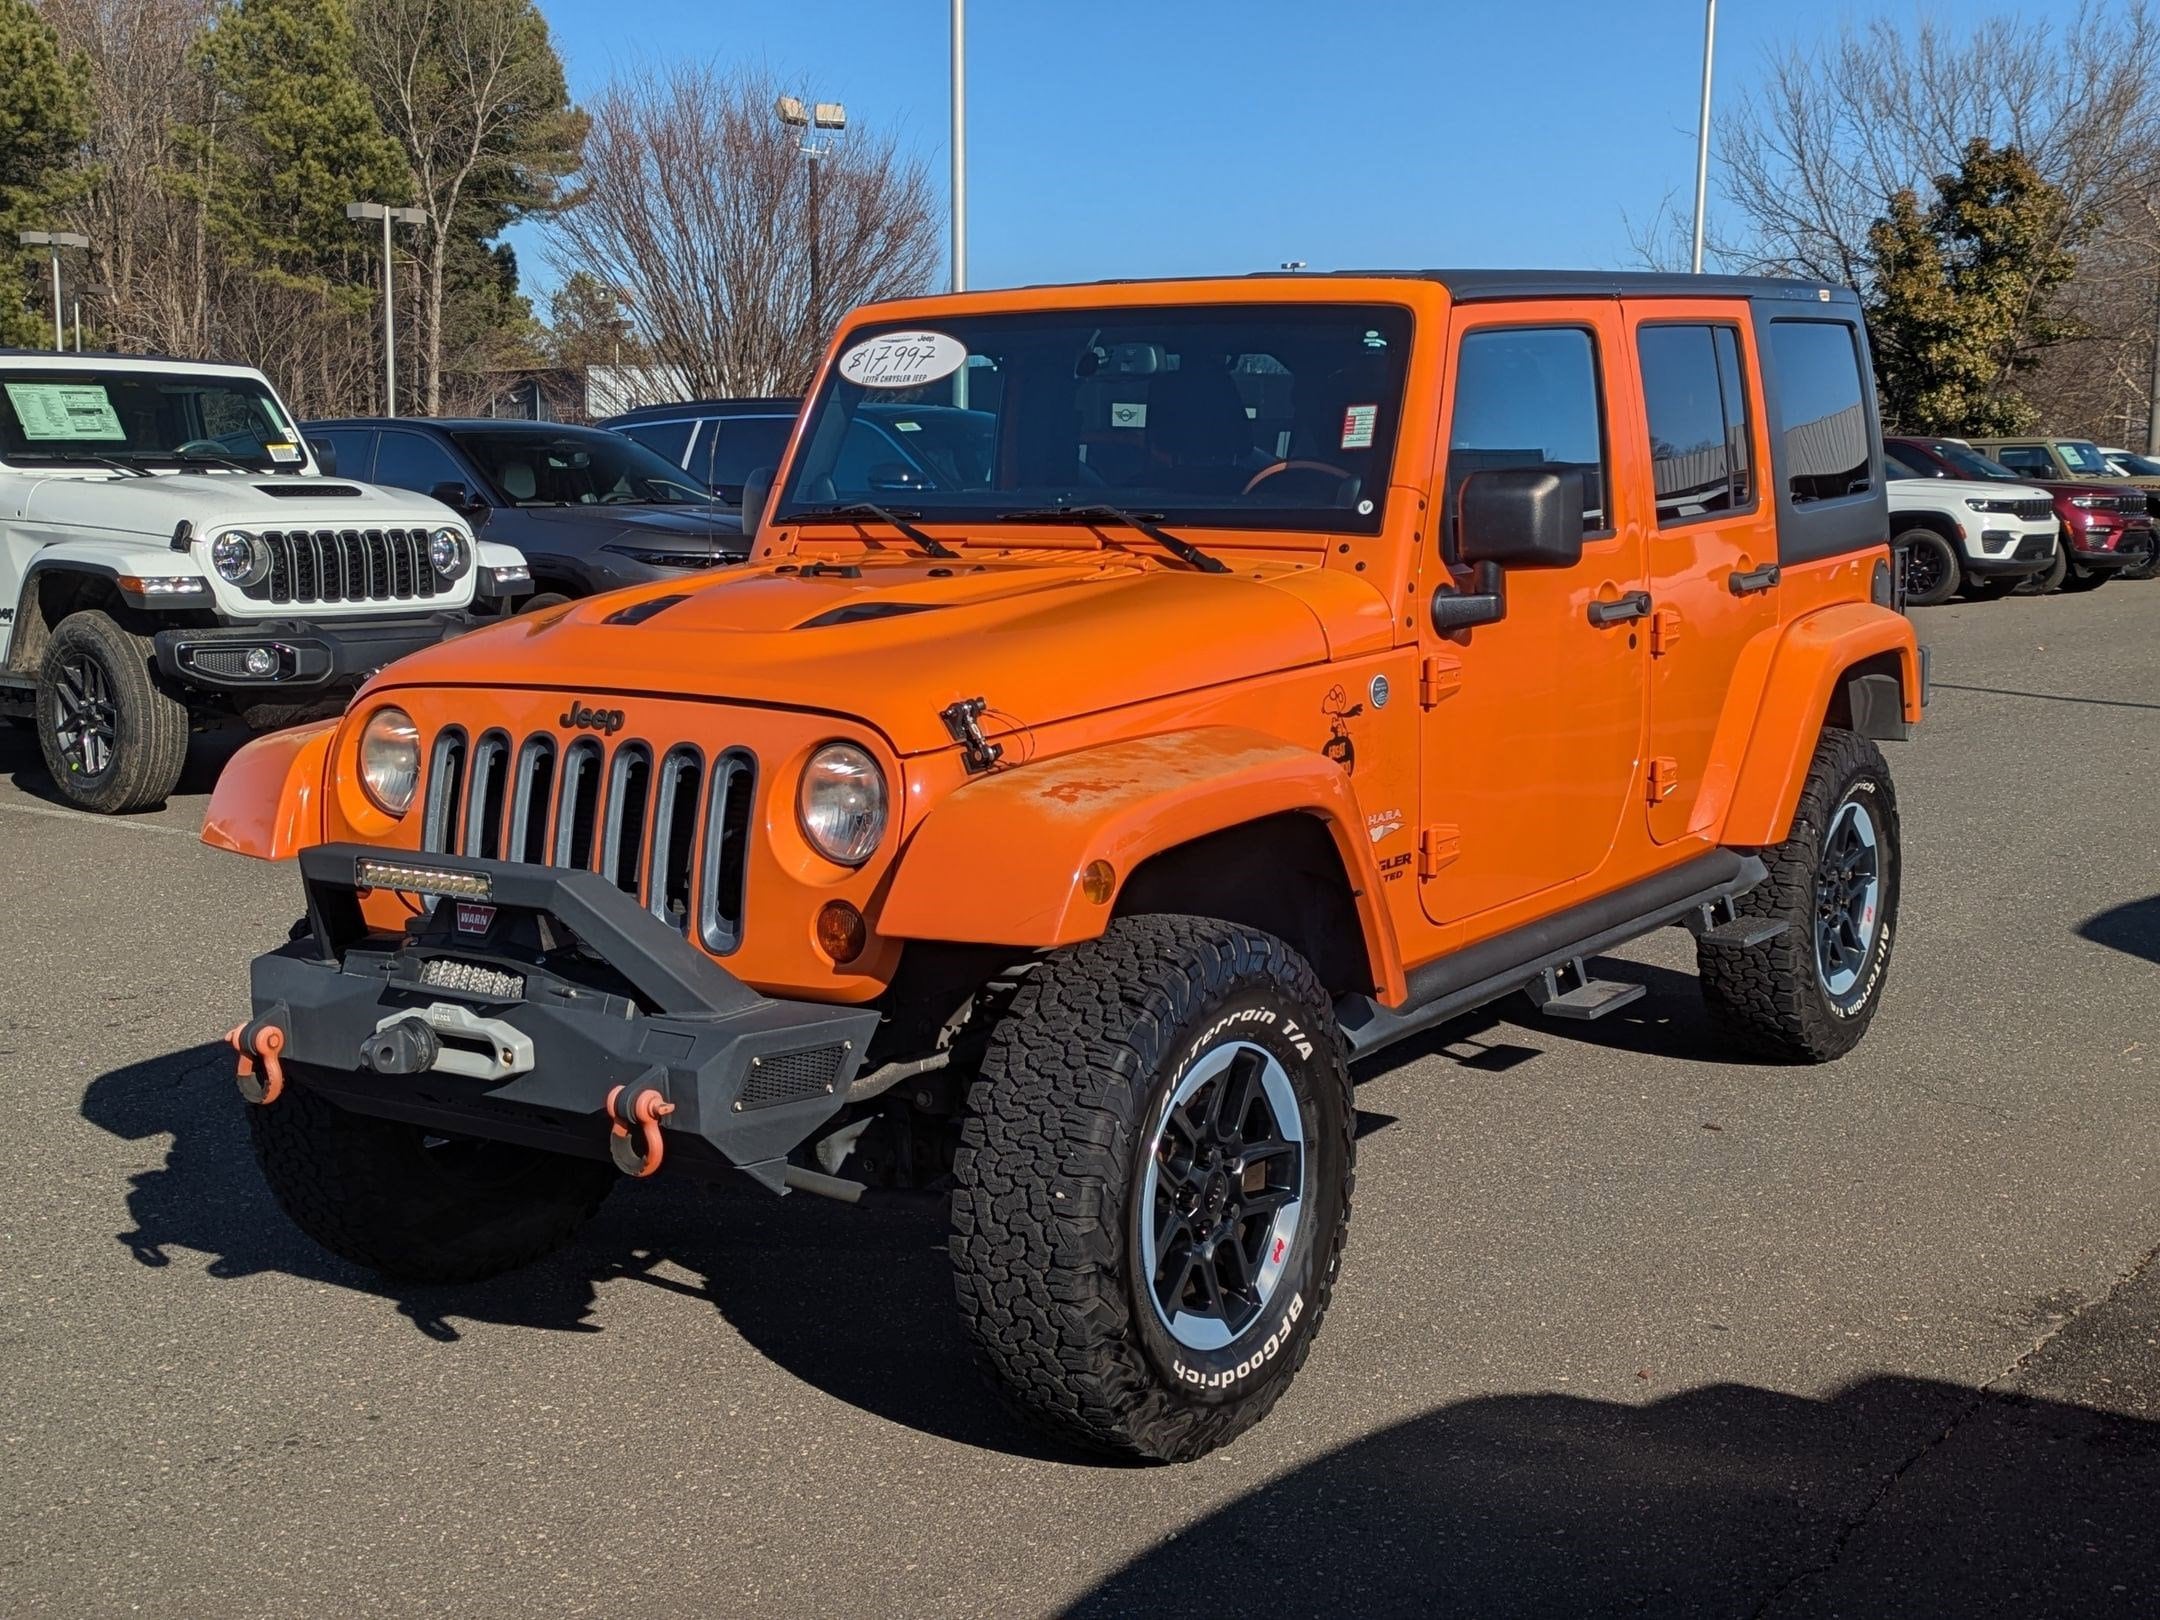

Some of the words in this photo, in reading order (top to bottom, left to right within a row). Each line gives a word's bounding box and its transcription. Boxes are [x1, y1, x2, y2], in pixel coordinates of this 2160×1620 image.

[847, 346, 936, 376] $17,997
[862, 375, 879, 384] LEITH
[880, 374, 911, 383] CHRYSLER
[912, 374, 928, 382] JEEP
[559, 700, 626, 737] Jeep
[1368, 808, 1402, 826] HARA
[1379, 852, 1412, 871] GLER
[1383, 870, 1403, 882] TED
[461, 912, 488, 925] WARN
[1847, 922, 1890, 1015] All-Terrain
[1160, 1006, 1277, 1117] All-Terrain
[1282, 1019, 1314, 1061] T/A
[1172, 1292, 1304, 1389] BFGoodrich
